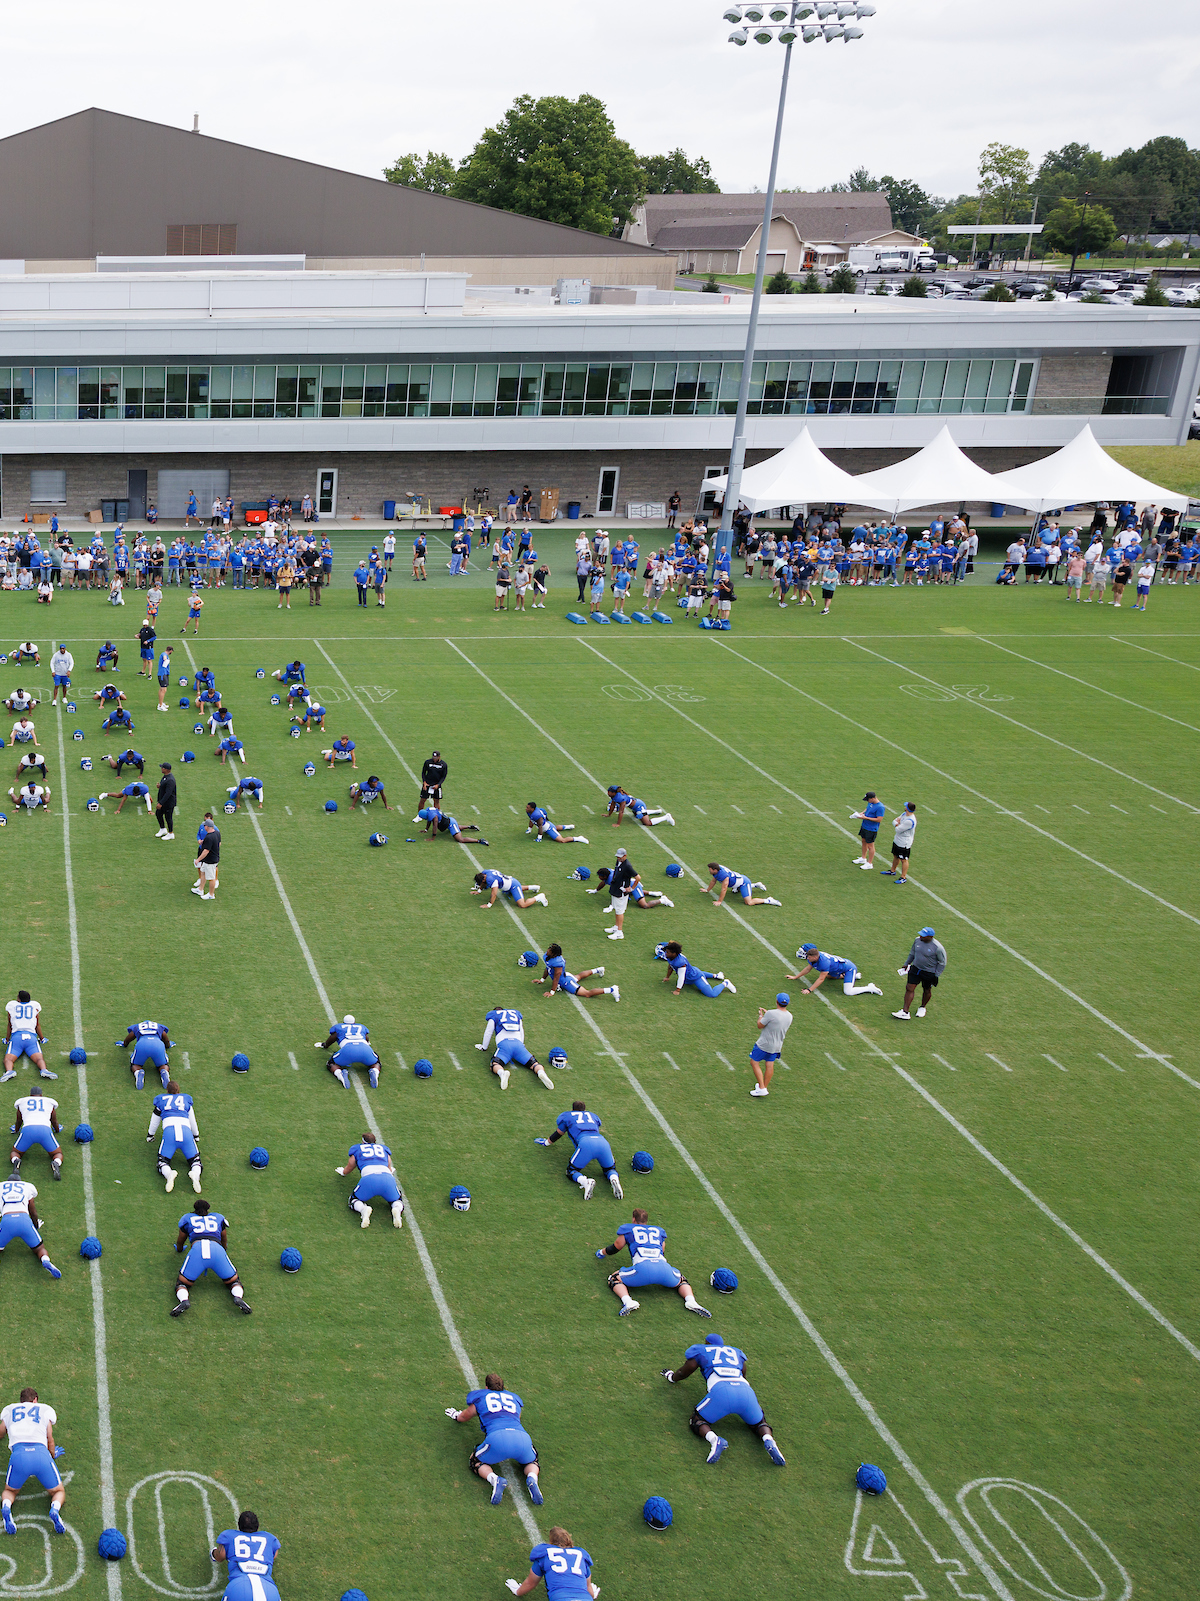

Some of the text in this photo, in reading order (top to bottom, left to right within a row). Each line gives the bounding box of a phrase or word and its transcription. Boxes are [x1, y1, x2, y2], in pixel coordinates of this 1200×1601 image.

[14, 1004, 34, 1020] 90
[496, 1009, 520, 1023] 75
[138, 1021, 159, 1031] 68
[341, 1024, 363, 1037] 77
[26, 1098, 45, 1112] 91
[162, 1095, 186, 1111] 74
[570, 1111, 596, 1125] 71
[359, 1143, 386, 1159] 58
[2, 1182, 26, 1195] 95
[189, 1215, 218, 1234] 56
[631, 1226, 661, 1246] 62
[705, 1346, 739, 1366] 79
[484, 1391, 518, 1415] 65
[11, 1404, 42, 1425] 64
[234, 1534, 267, 1562] 67
[546, 1547, 584, 1576] 57
